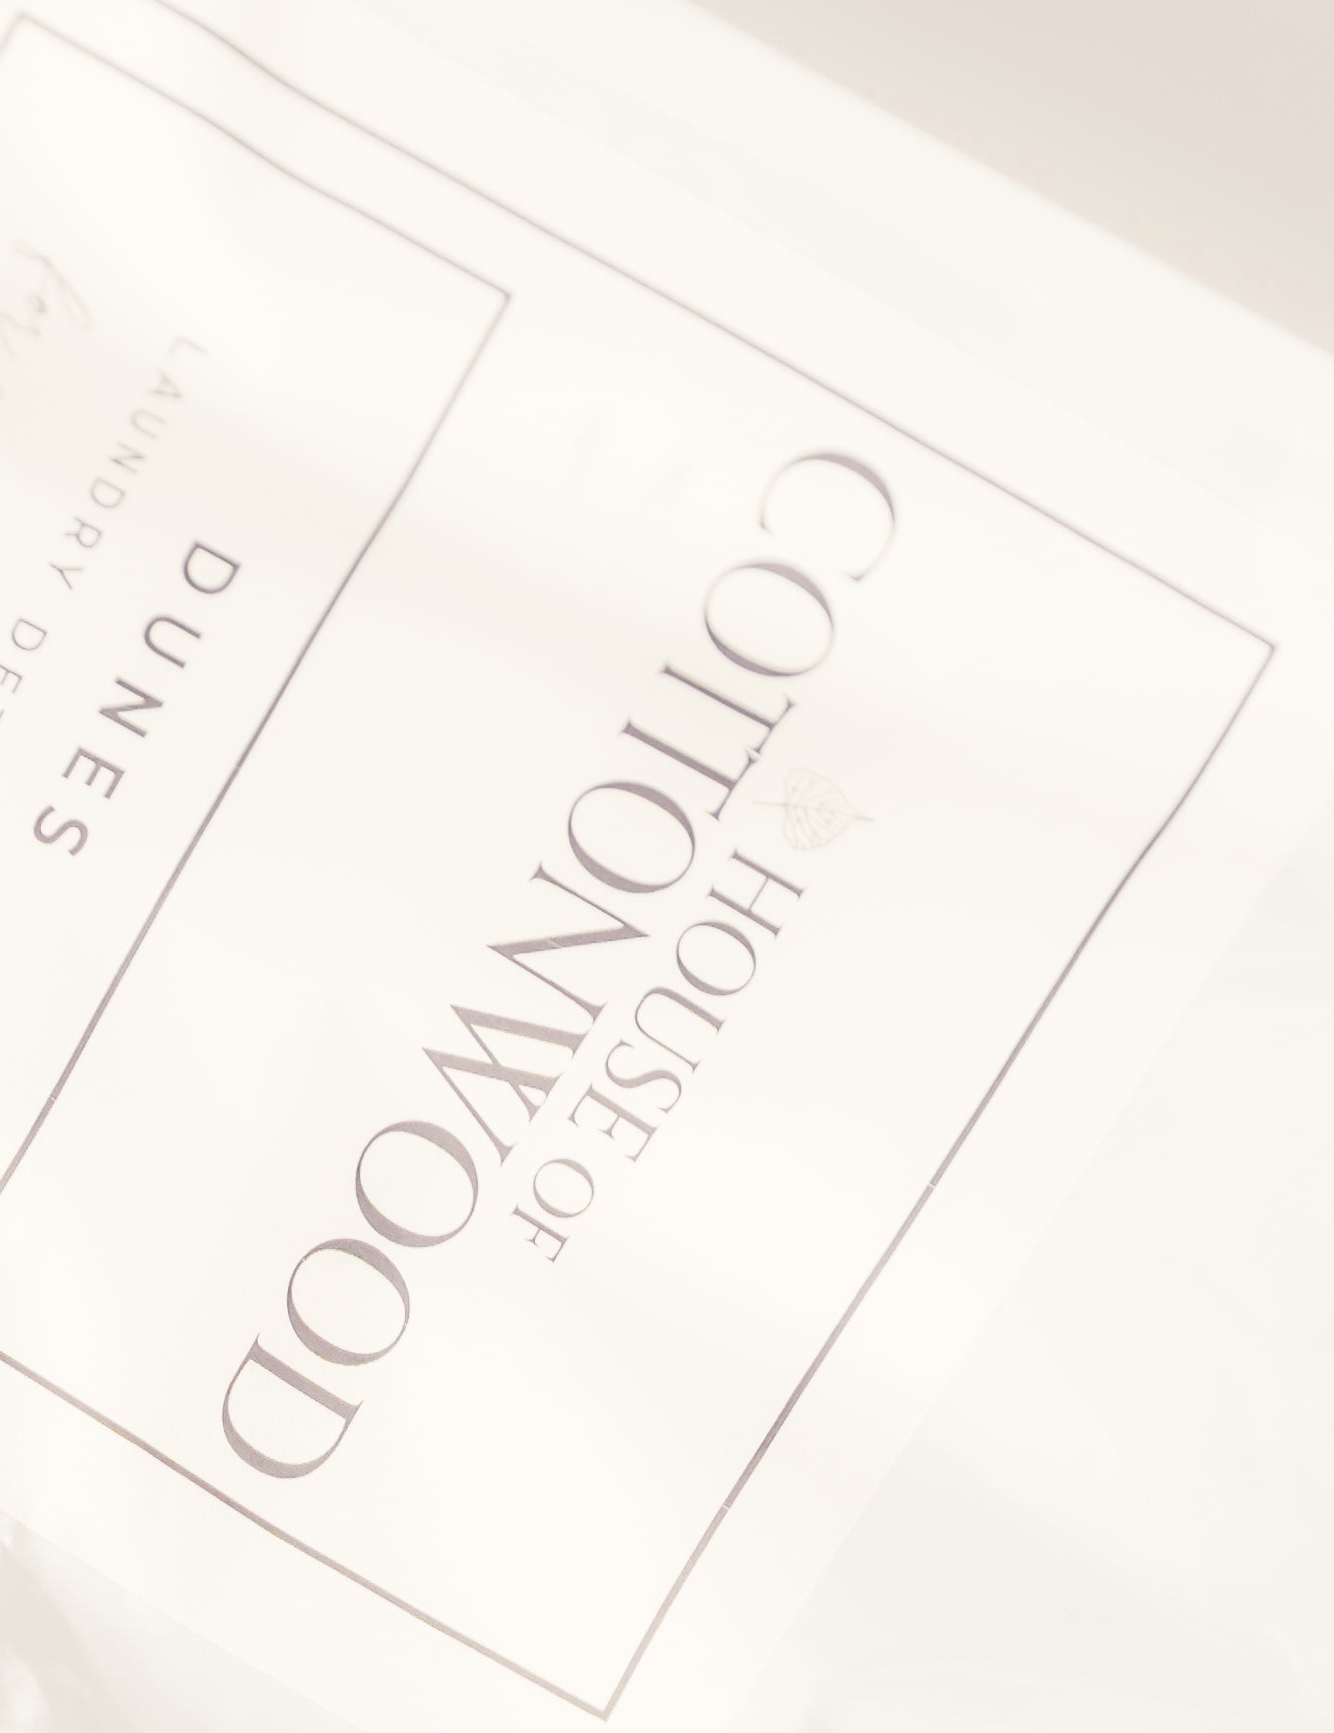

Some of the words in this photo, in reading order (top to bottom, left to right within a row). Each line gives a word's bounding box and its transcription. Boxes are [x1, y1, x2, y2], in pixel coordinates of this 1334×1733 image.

[49, 335, 208, 590] LAUNDRY
[32, 540, 242, 858] DUNES
[220, 446, 897, 1482] COTTONWOOD
[571, 851, 806, 1163] HOUSE
[508, 1155, 596, 1264] OF
